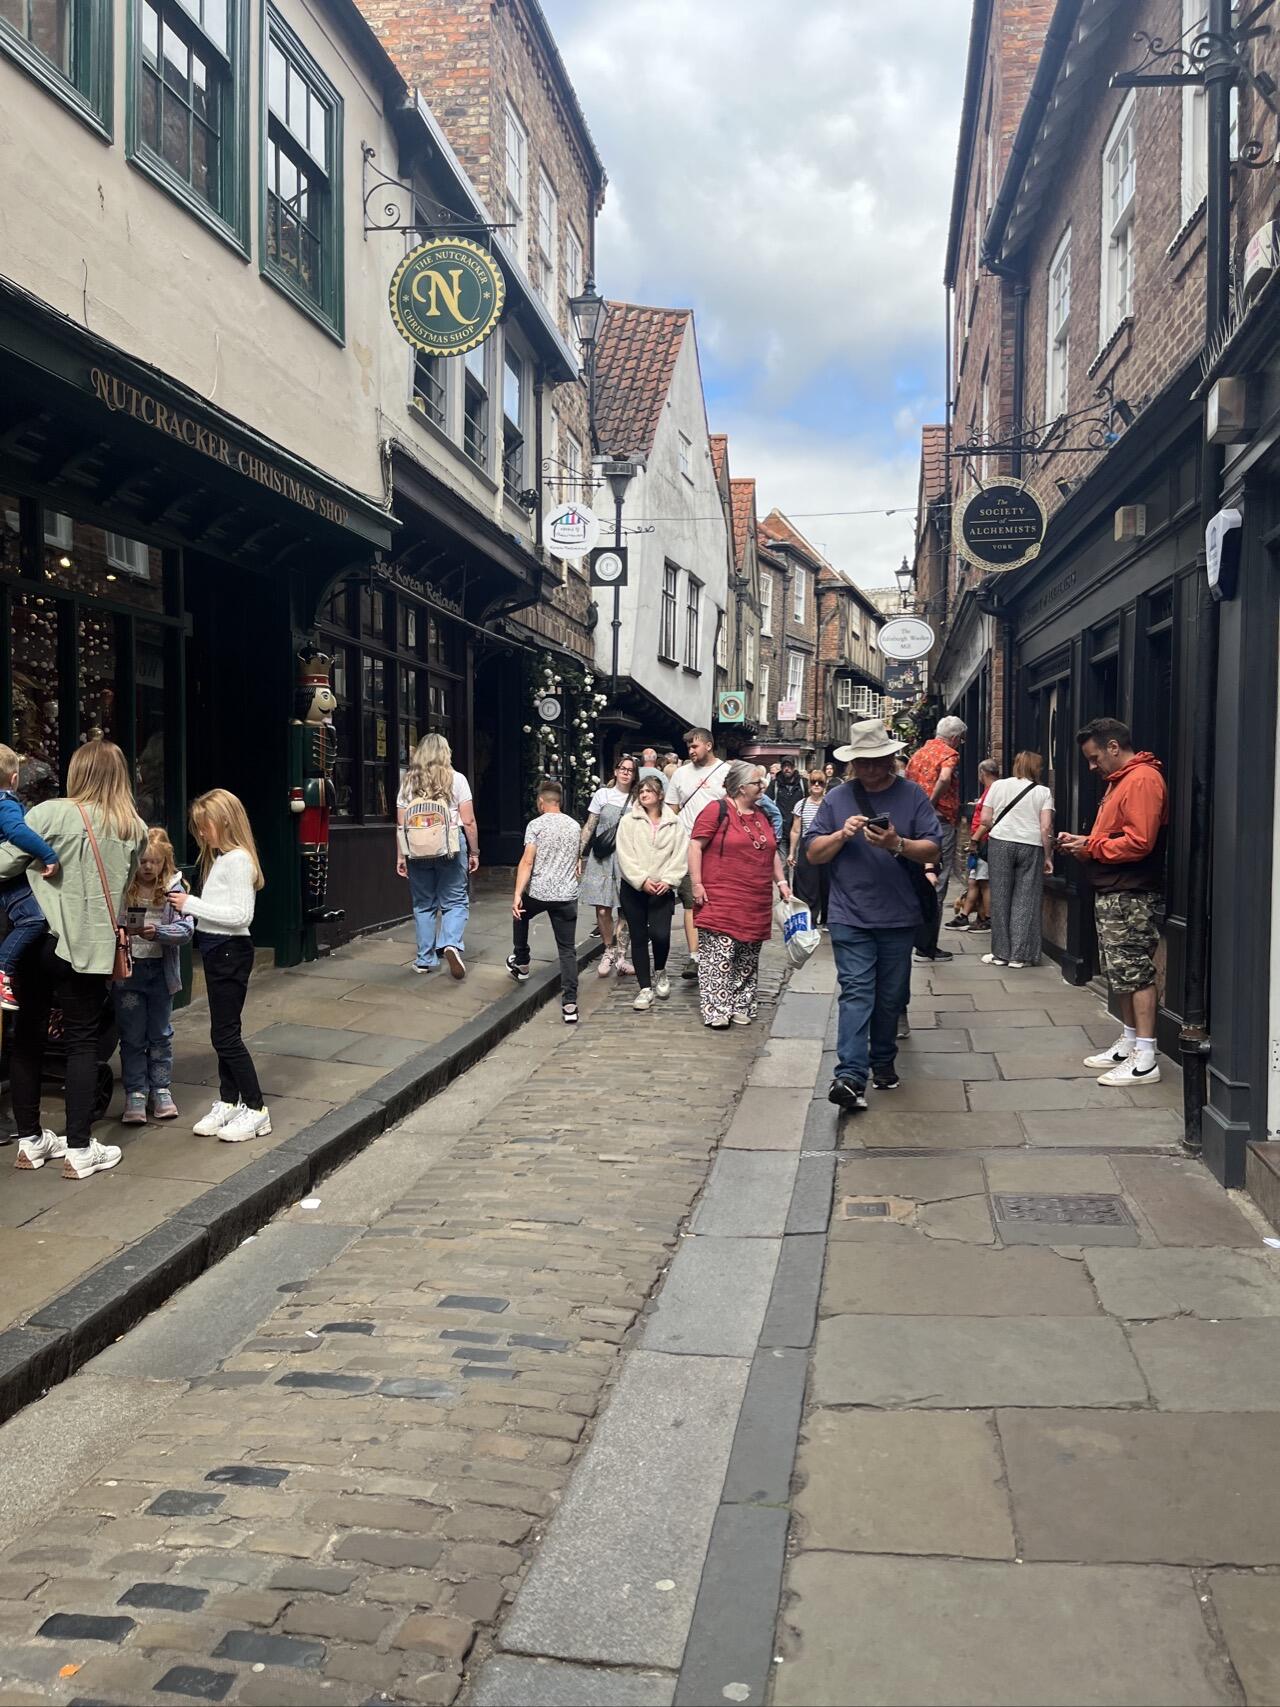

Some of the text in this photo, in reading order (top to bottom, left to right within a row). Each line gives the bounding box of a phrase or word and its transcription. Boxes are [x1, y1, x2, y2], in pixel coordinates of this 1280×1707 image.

[413, 251, 488, 285] THE NUTCRACKER
[412, 269, 480, 325] N
[404, 309, 474, 343] CHRISTMAS SHOP
[90, 367, 349, 527] NUTCRACKER CHRISTMAS SHOP
[979, 507, 1025, 516] SOCIETY
[997, 498, 1008, 506] The
[969, 525, 1037, 535] ALCHEMISTS
[395, 564, 424, 594] Korean
